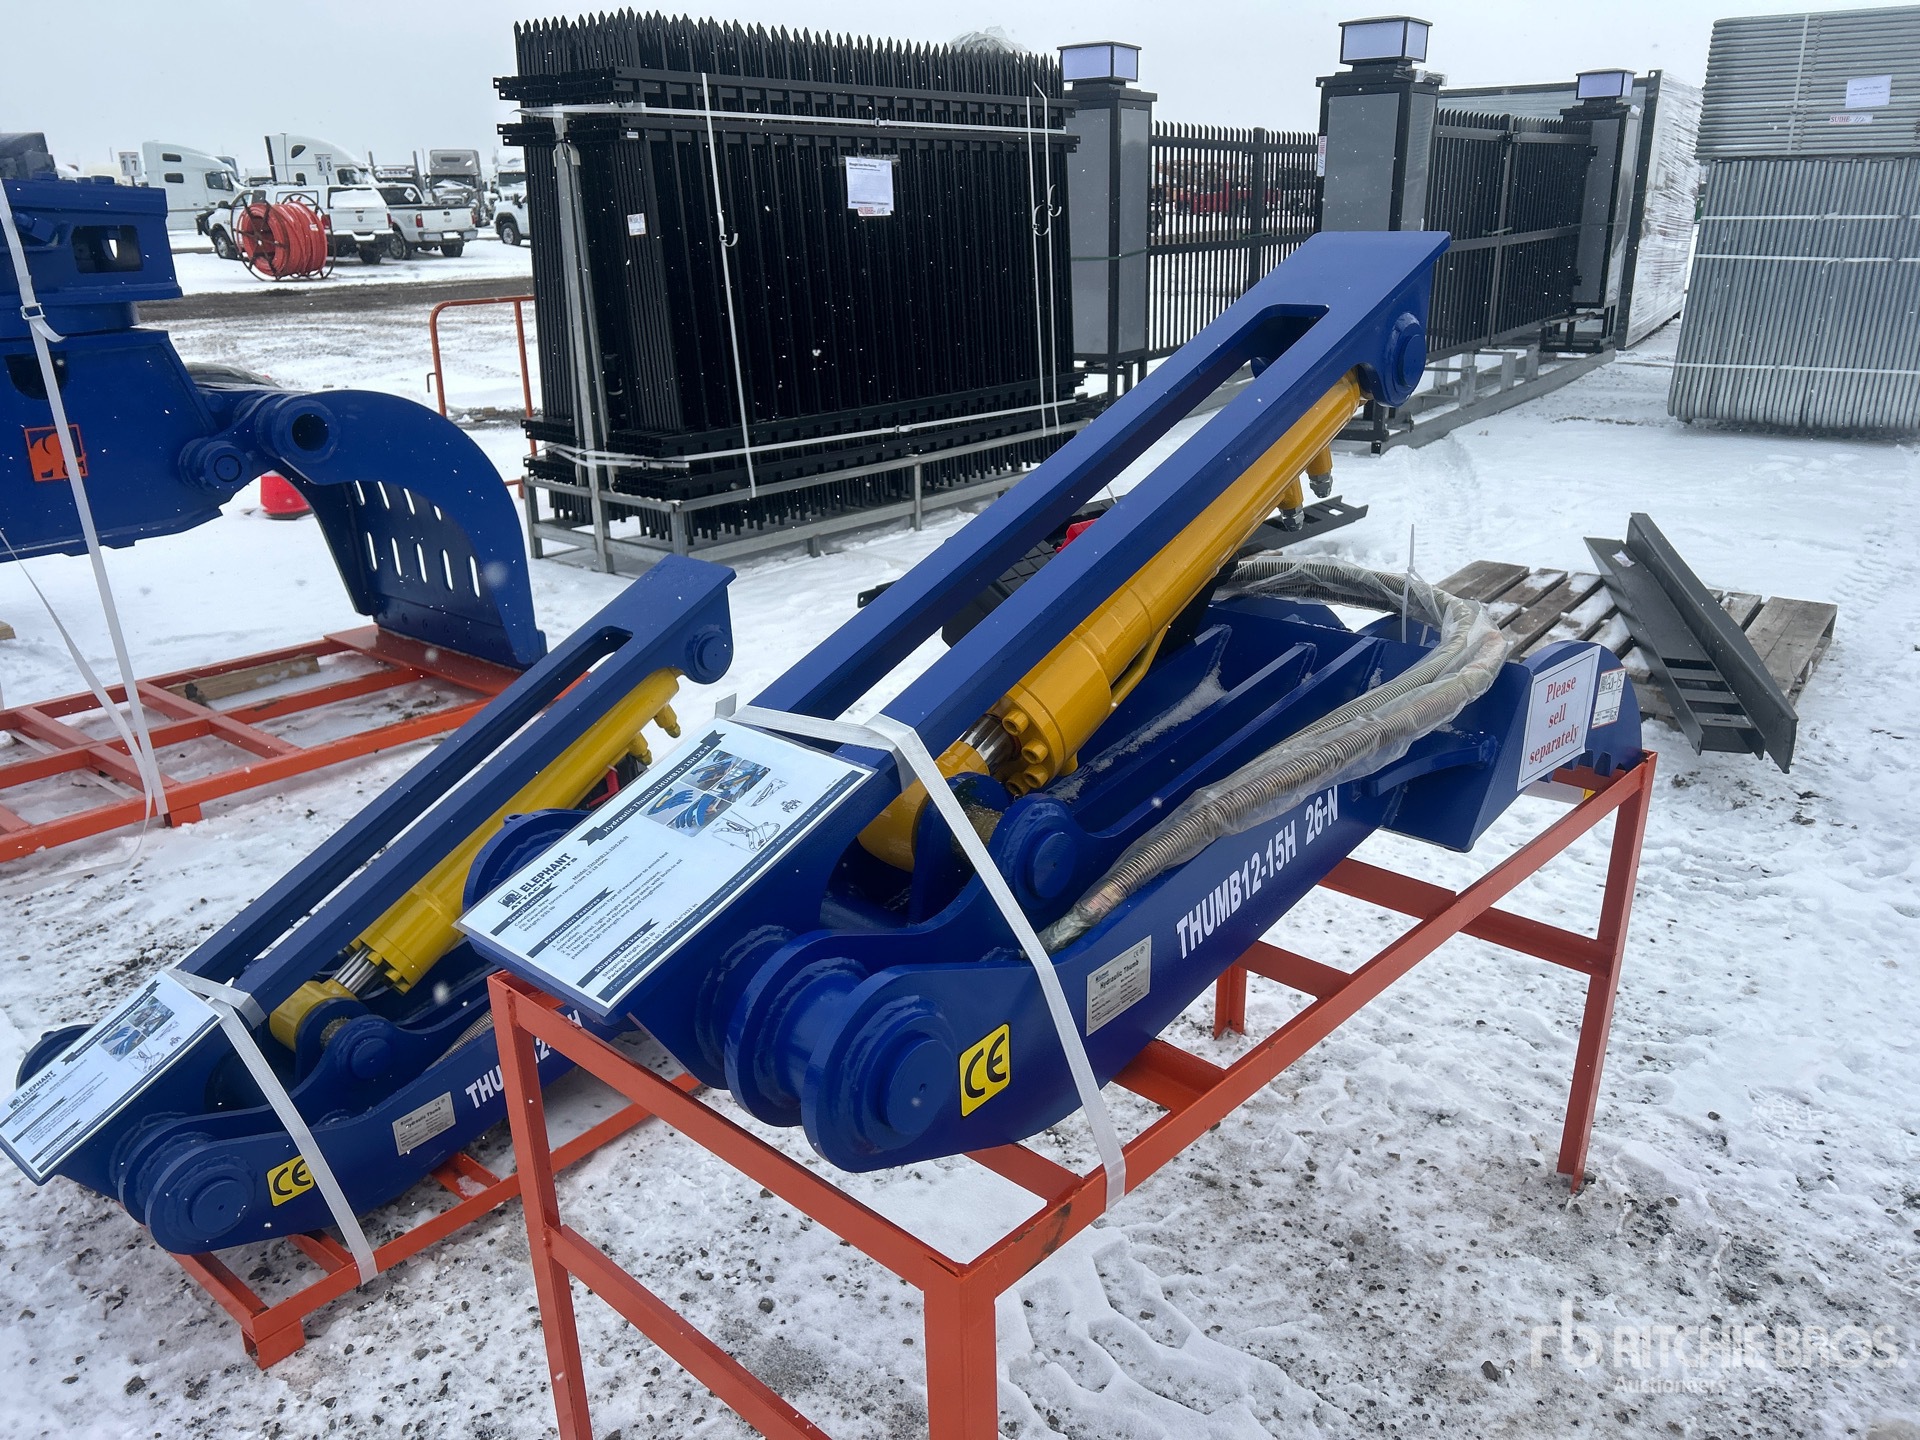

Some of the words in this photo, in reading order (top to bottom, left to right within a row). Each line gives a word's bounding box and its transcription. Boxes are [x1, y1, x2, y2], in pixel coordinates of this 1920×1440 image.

[1546, 676, 1576, 704] Please
[1548, 703, 1567, 728] sell
[1529, 724, 1579, 764] separately
[601, 806, 637, 832] Hydraulic
[508, 856, 578, 910] ATTACHMENTS
[518, 852, 573, 892] ELEPHANT
[1176, 820, 1297, 959] THUMB12-15H
[1305, 784, 1338, 846] 26-N
[506, 892, 545, 923] Specification
[544, 917, 577, 944] Production
[574, 897, 601, 918] Features
[593, 949, 622, 973] Shipping
[619, 929, 646, 951] Package
[601, 957, 625, 977] Shipping
[606, 962, 628, 980] Package
[1100, 970, 1122, 990] Hydraulic
[1124, 960, 1139, 974] Thumb
[965, 1033, 1006, 1098] CE
[20, 1069, 54, 1098] ELEPHANT
[272, 1160, 311, 1196] CE
